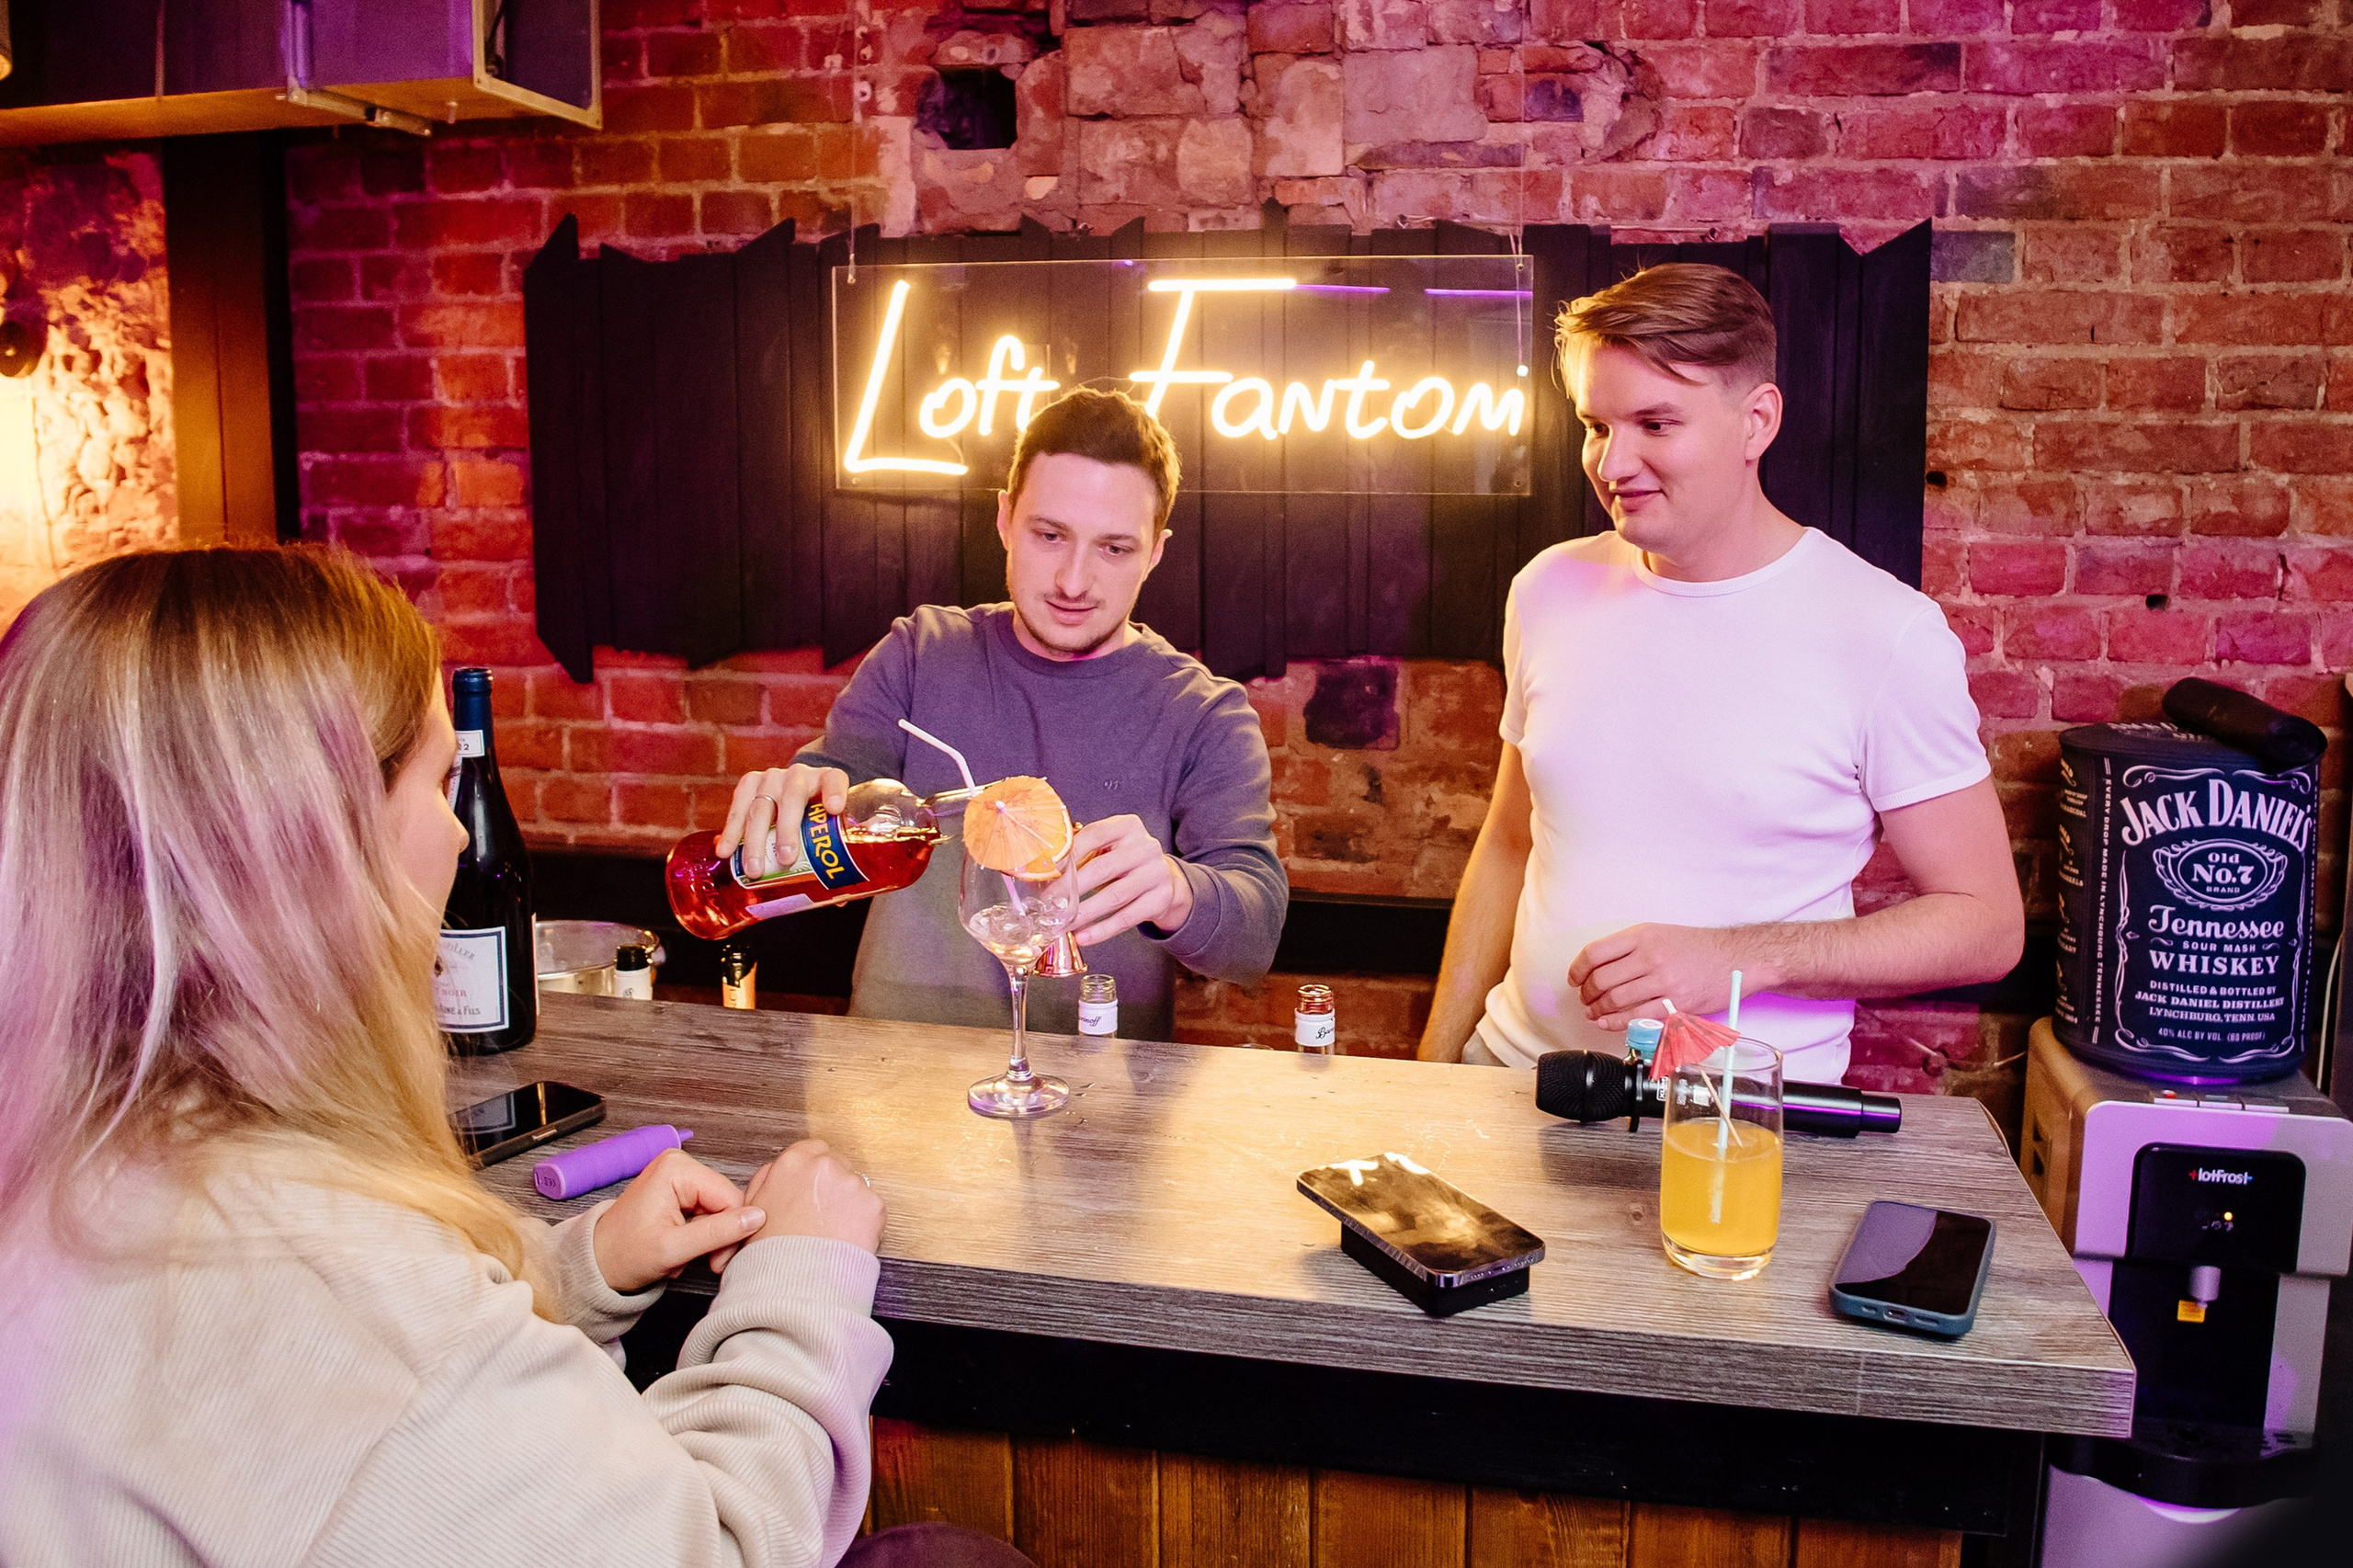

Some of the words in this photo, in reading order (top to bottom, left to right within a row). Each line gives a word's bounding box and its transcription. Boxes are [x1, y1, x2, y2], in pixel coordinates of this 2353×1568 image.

[844, 278, 1062, 476] Loft
[1129, 276, 1527, 441] Fantom
[2104, 778, 2112, 814] EVERY
[2120, 790, 2205, 846] JACK
[2208, 778, 2313, 853] DANIEL'S
[808, 803, 845, 880] APEROL
[2208, 852, 2240, 864] Old
[2100, 881, 2107, 892] IN
[2206, 885, 2241, 893] BRAND
[2097, 894, 2106, 959] LYNCHBURG
[2148, 904, 2284, 939] Tennessee
[2182, 940, 2217, 952] SOUR
[2223, 943, 2256, 953] MASH
[2149, 949, 2279, 976] WHISKEY
[442, 989, 467, 997] NOIR
[2095, 961, 2104, 1023] TENNESSEE
[2150, 980, 2207, 994] DISTILLED
[2209, 986, 2218, 995] &
[2220, 986, 2265, 996] BOTTLED
[2267, 985, 2277, 994] BY
[2135, 991, 2167, 1004] JACK
[2171, 995, 2220, 1009] DANIEL
[2222, 996, 2285, 1009] DISTILLERY
[2158, 1028, 2175, 1038] 40%
[2194, 1030, 2205, 1040] BY
